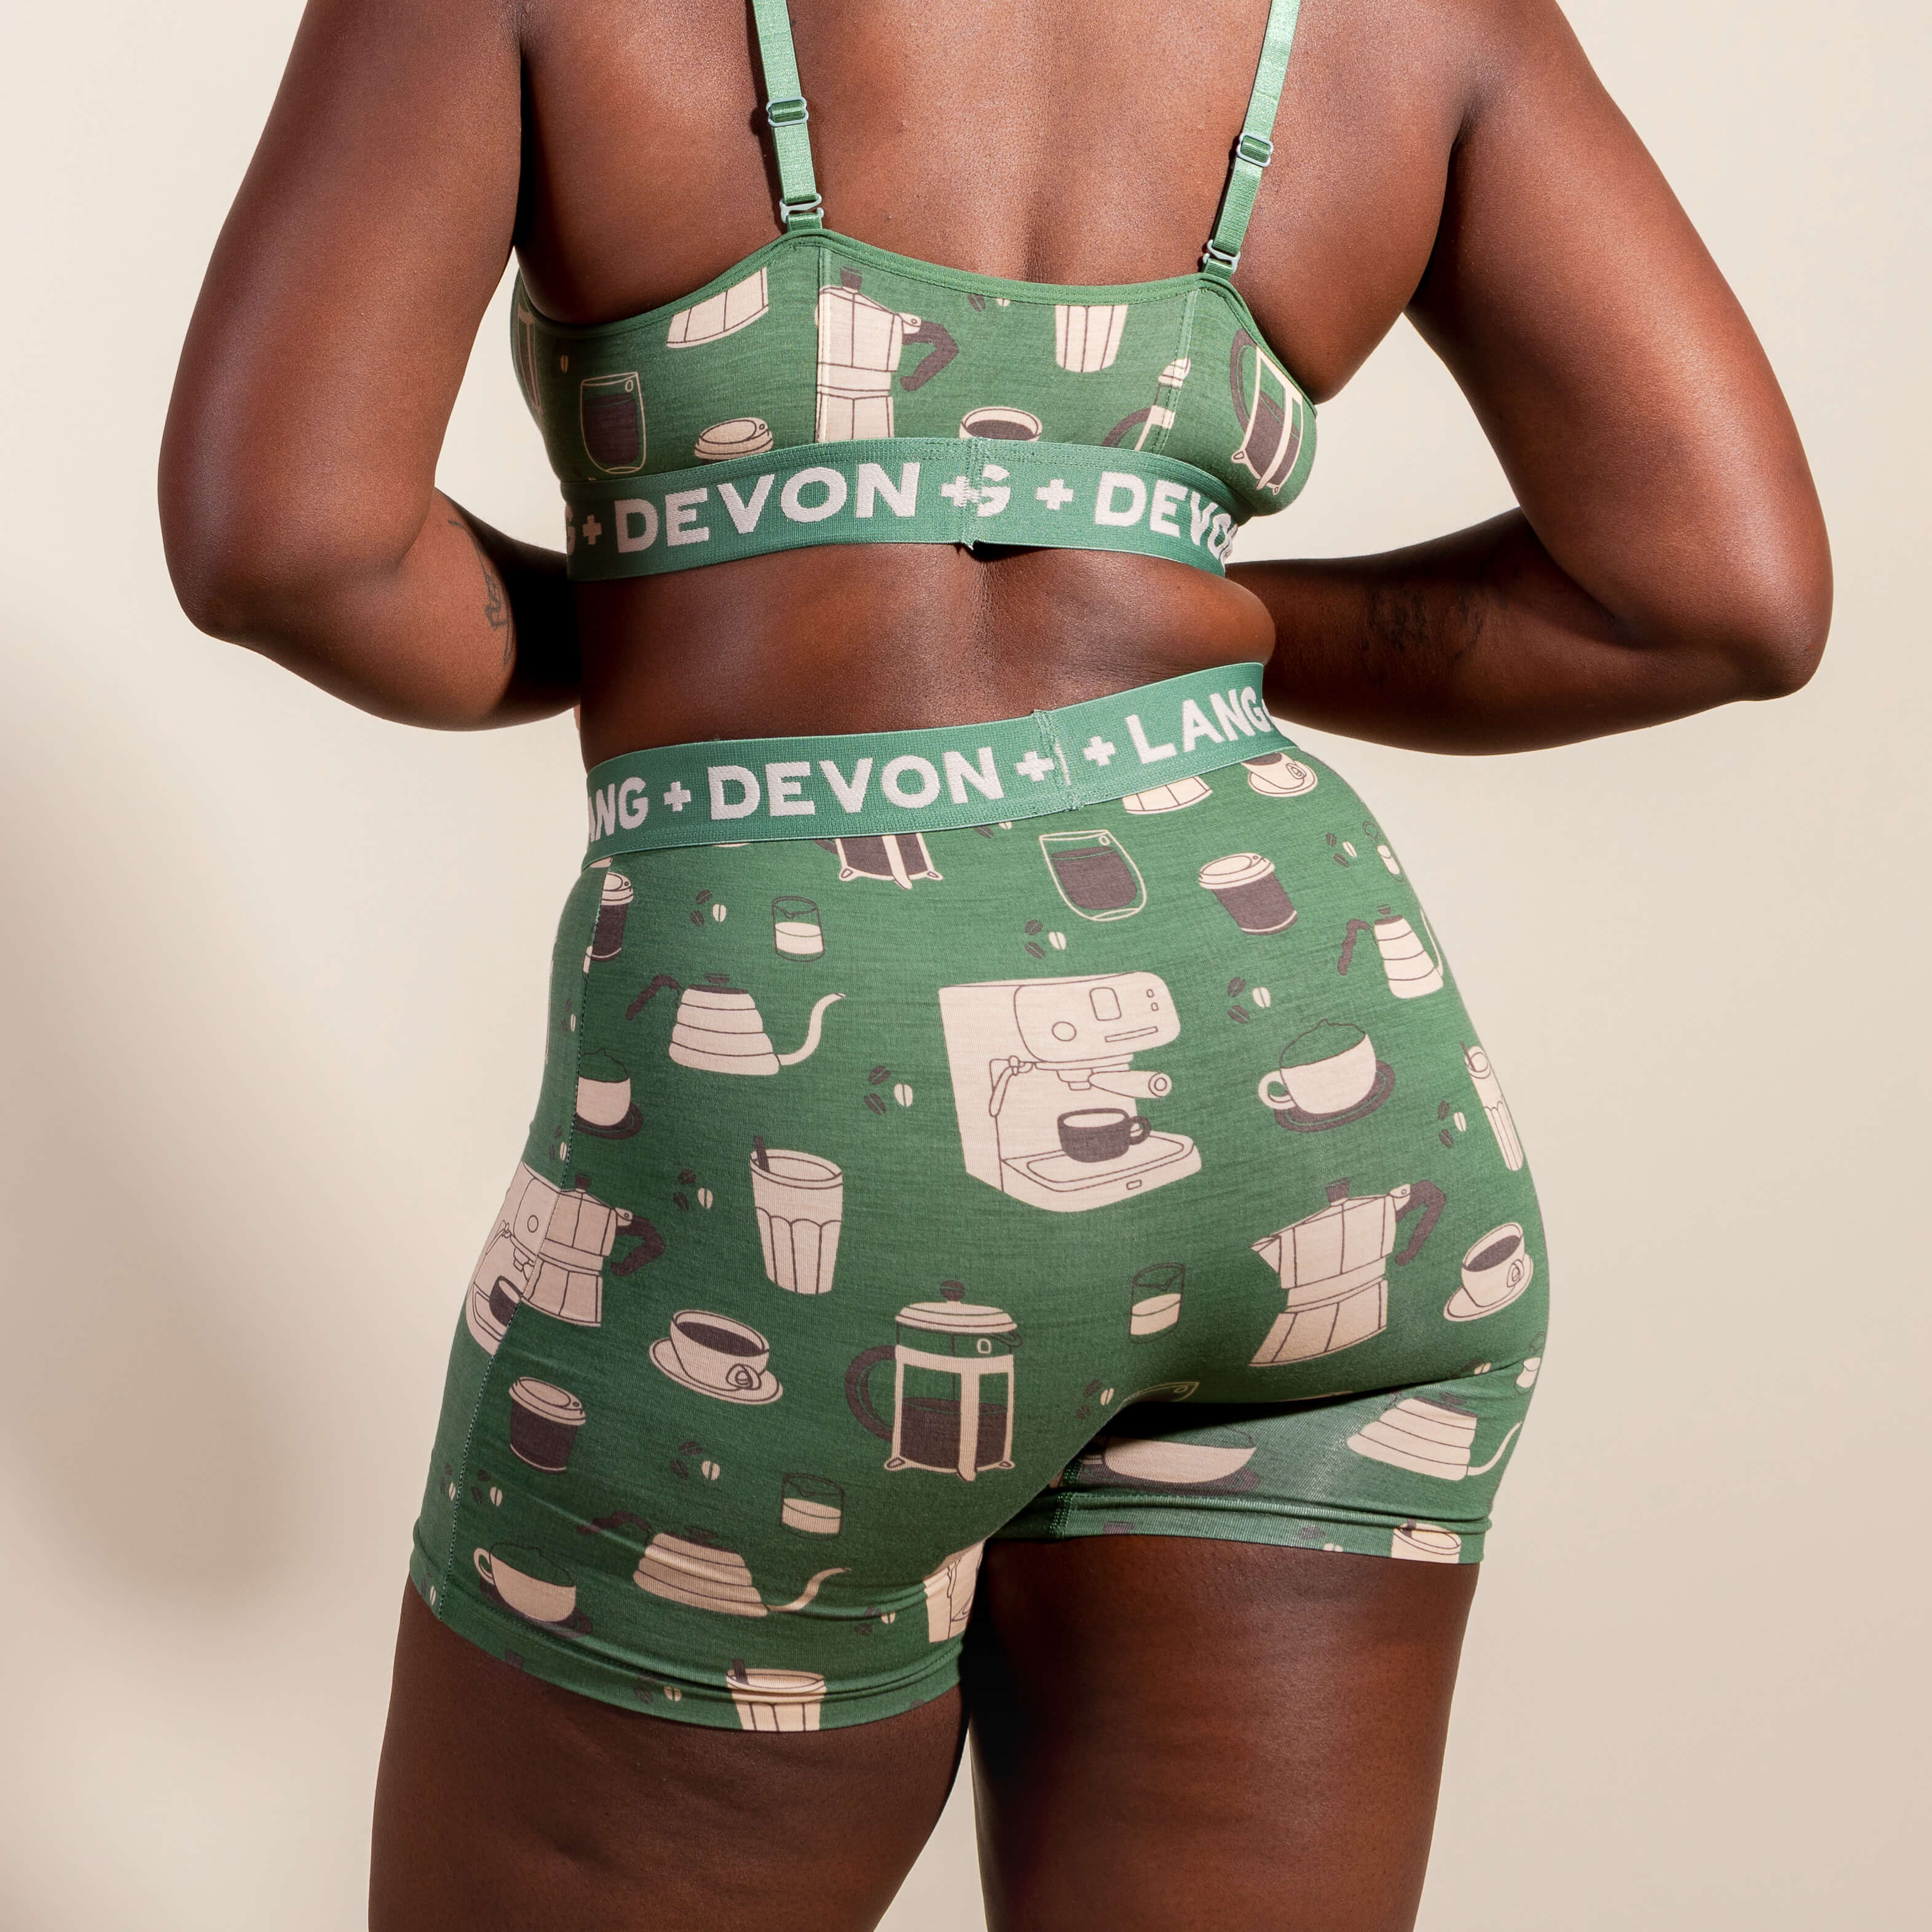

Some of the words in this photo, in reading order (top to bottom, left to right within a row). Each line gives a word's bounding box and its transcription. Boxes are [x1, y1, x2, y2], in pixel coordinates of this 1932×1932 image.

[615, 462, 921, 553] DEVON
[1124, 686, 1271, 764] LANG
[708, 747, 1004, 820] DEVON
